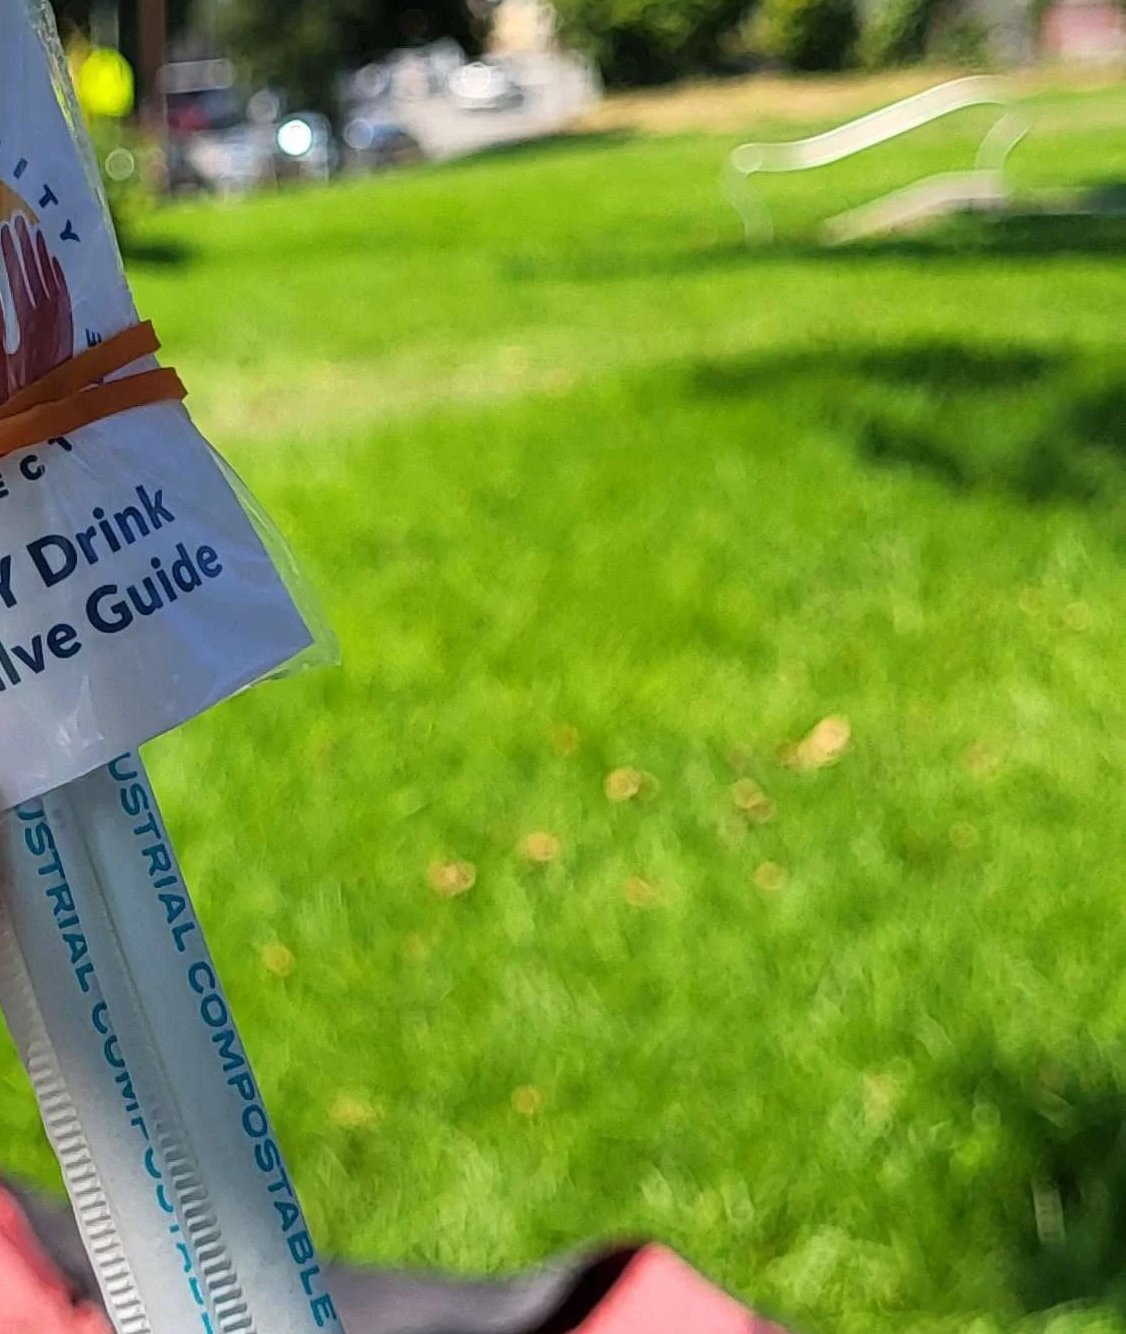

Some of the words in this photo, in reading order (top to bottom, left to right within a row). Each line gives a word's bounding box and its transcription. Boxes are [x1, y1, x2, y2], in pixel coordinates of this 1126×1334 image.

[25, 484, 177, 589] Drink
[85, 541, 224, 635] Guide
[187, 960, 338, 1329] COMPOSTABLE
